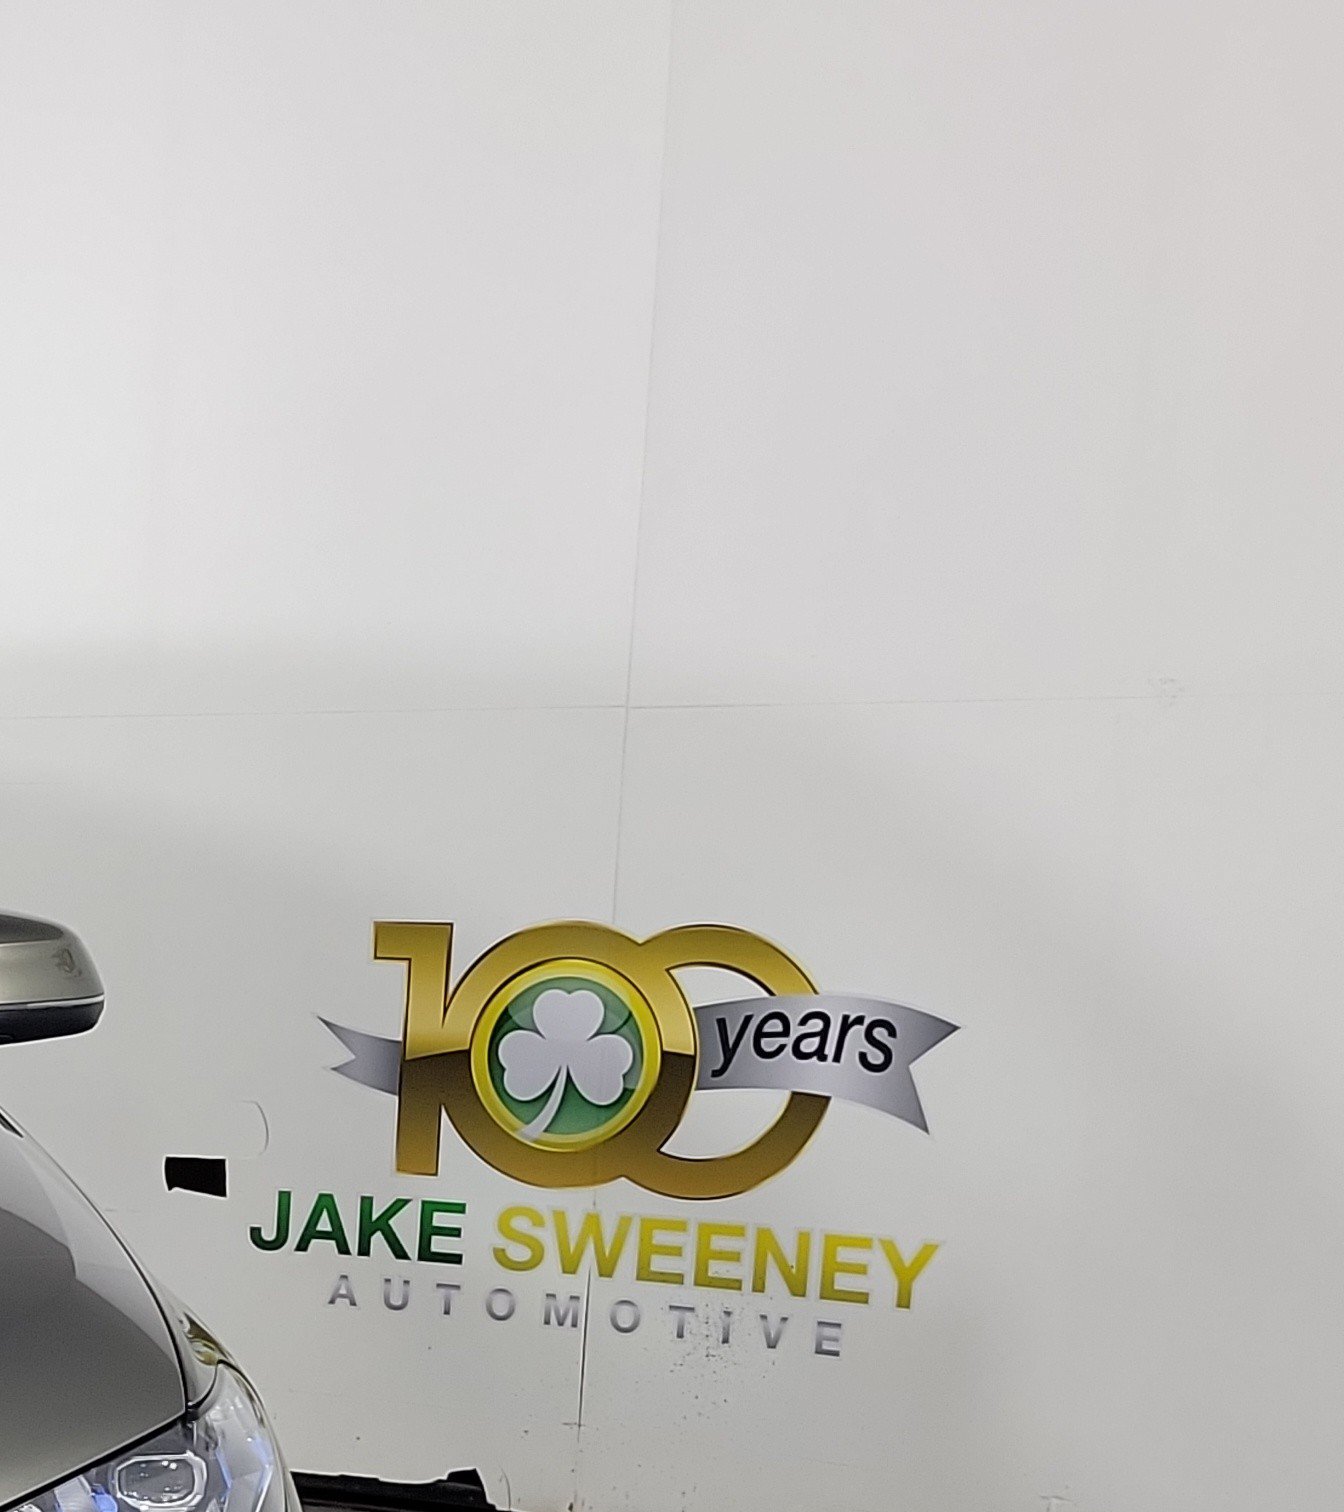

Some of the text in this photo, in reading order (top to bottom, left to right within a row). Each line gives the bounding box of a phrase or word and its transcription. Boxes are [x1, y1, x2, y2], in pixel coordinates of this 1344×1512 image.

[374, 920, 898, 1200] 100 years
[249, 1190, 940, 1310] JAKE SWEENEY
[328, 1274, 843, 1358] AUTOMOTIVE
